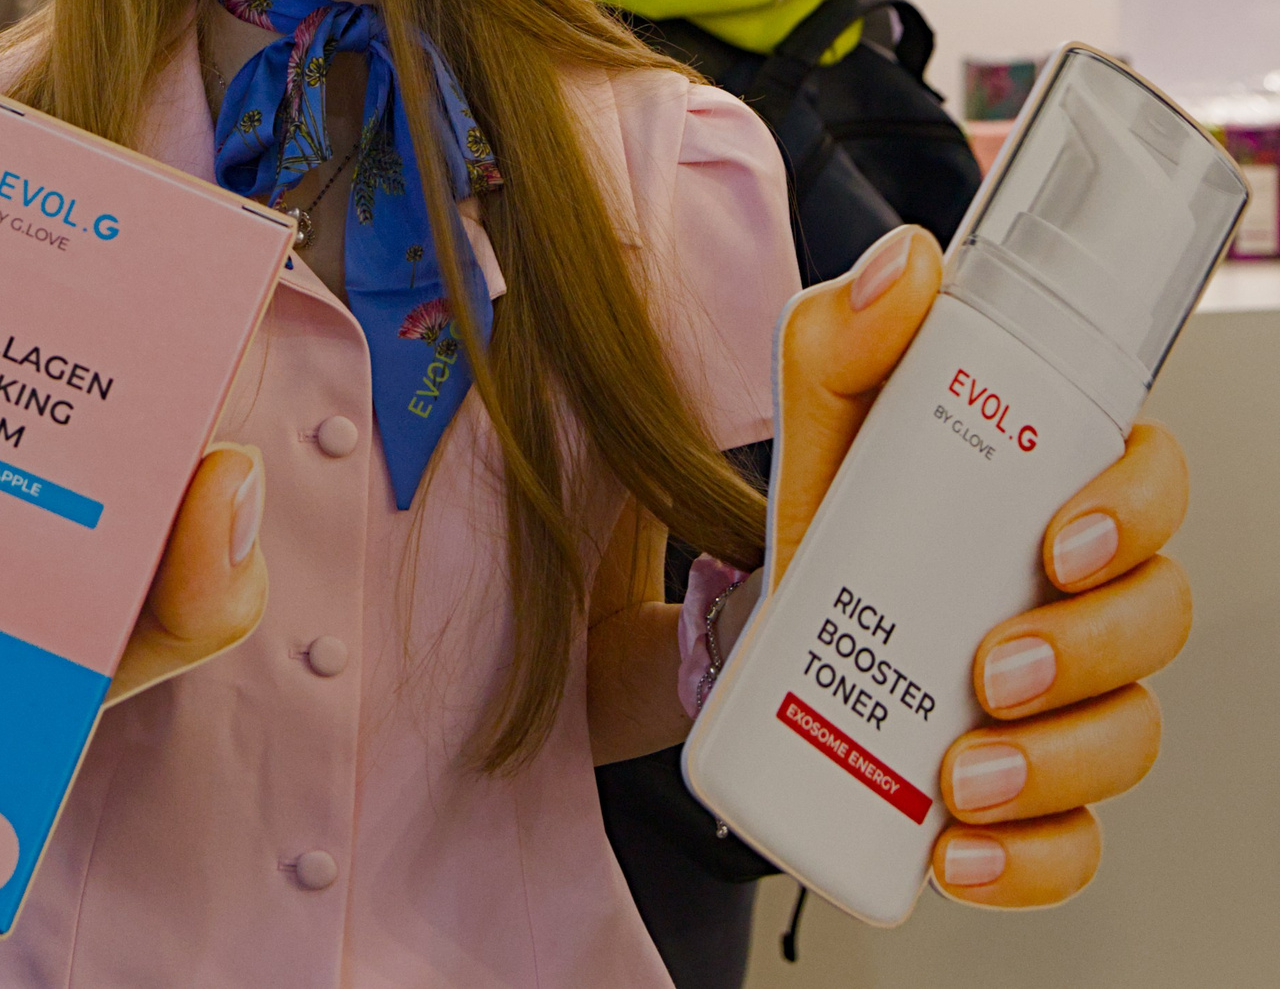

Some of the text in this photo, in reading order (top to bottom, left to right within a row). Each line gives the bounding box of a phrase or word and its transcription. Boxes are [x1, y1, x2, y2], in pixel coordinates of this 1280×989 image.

[10, 216, 70, 252] G.LOVE
[933, 404, 997, 461] BY G.LOVE
[947, 368, 1039, 453] EVOL.G
[833, 586, 897, 645] RICH
[802, 650, 889, 731] TONER
[817, 618, 936, 722] BOOSTER
[785, 702, 900, 795] EXOSOME ENERGY
